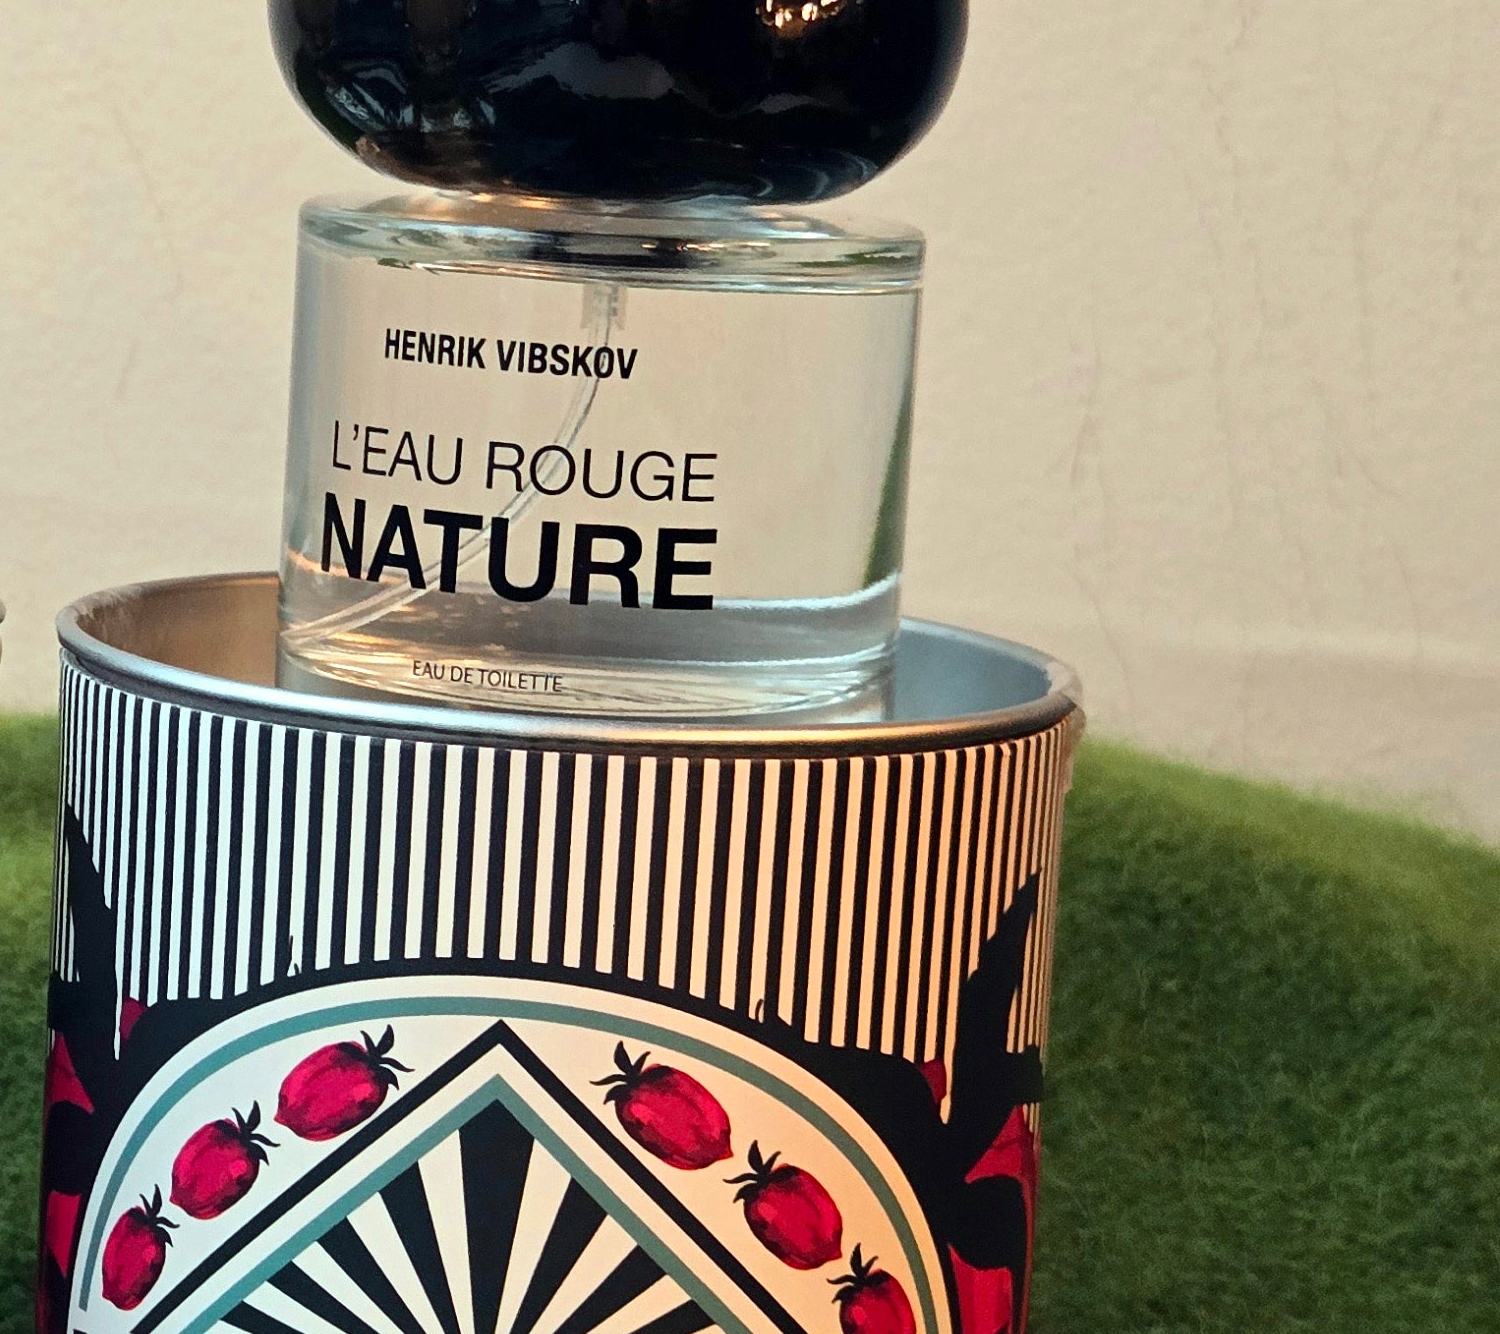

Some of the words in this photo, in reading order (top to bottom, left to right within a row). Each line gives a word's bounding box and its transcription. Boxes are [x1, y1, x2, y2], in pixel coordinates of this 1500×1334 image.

[384, 328, 486, 369] HENRIK
[496, 339, 638, 380] VIBSKOV
[331, 419, 464, 486] L'EAU
[485, 441, 718, 502] ROUGE
[320, 491, 718, 610] NATURE
[412, 659, 445, 680] EAU
[450, 665, 474, 685] DE
[477, 668, 565, 693] TOILETTE
